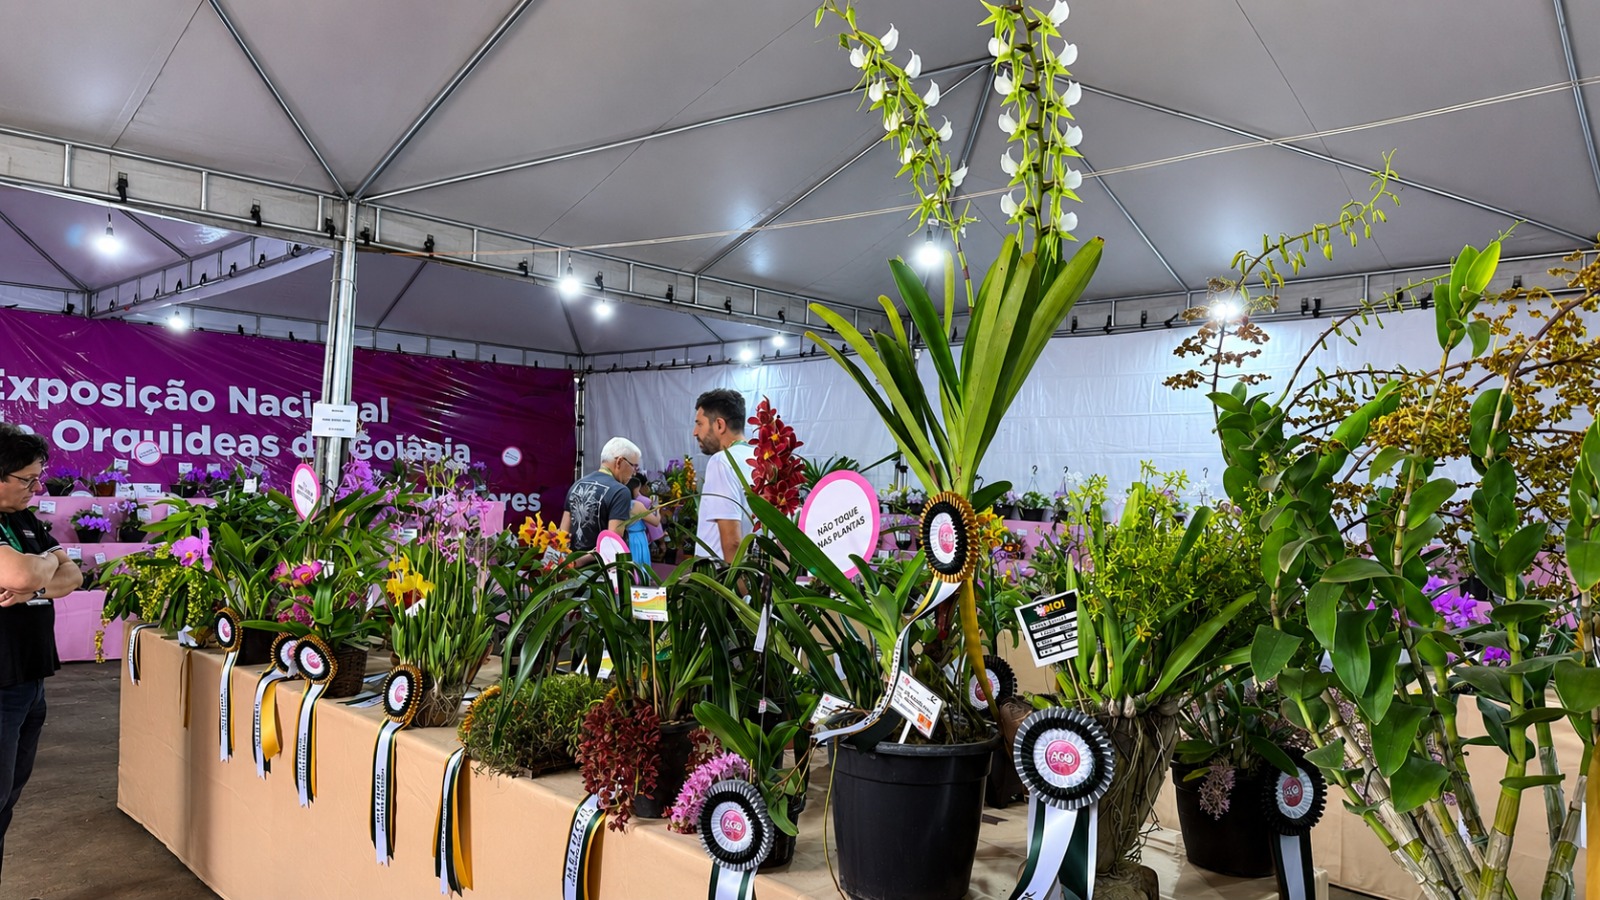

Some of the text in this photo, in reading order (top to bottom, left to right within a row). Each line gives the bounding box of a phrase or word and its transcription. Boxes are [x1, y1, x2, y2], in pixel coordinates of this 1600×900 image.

[0, 369, 216, 415] xposição
[228, 386, 390, 423] Nacial
[817, 506, 859, 536] NÃO TOQUE
[817, 516, 866, 549] NAS PLANTAS
